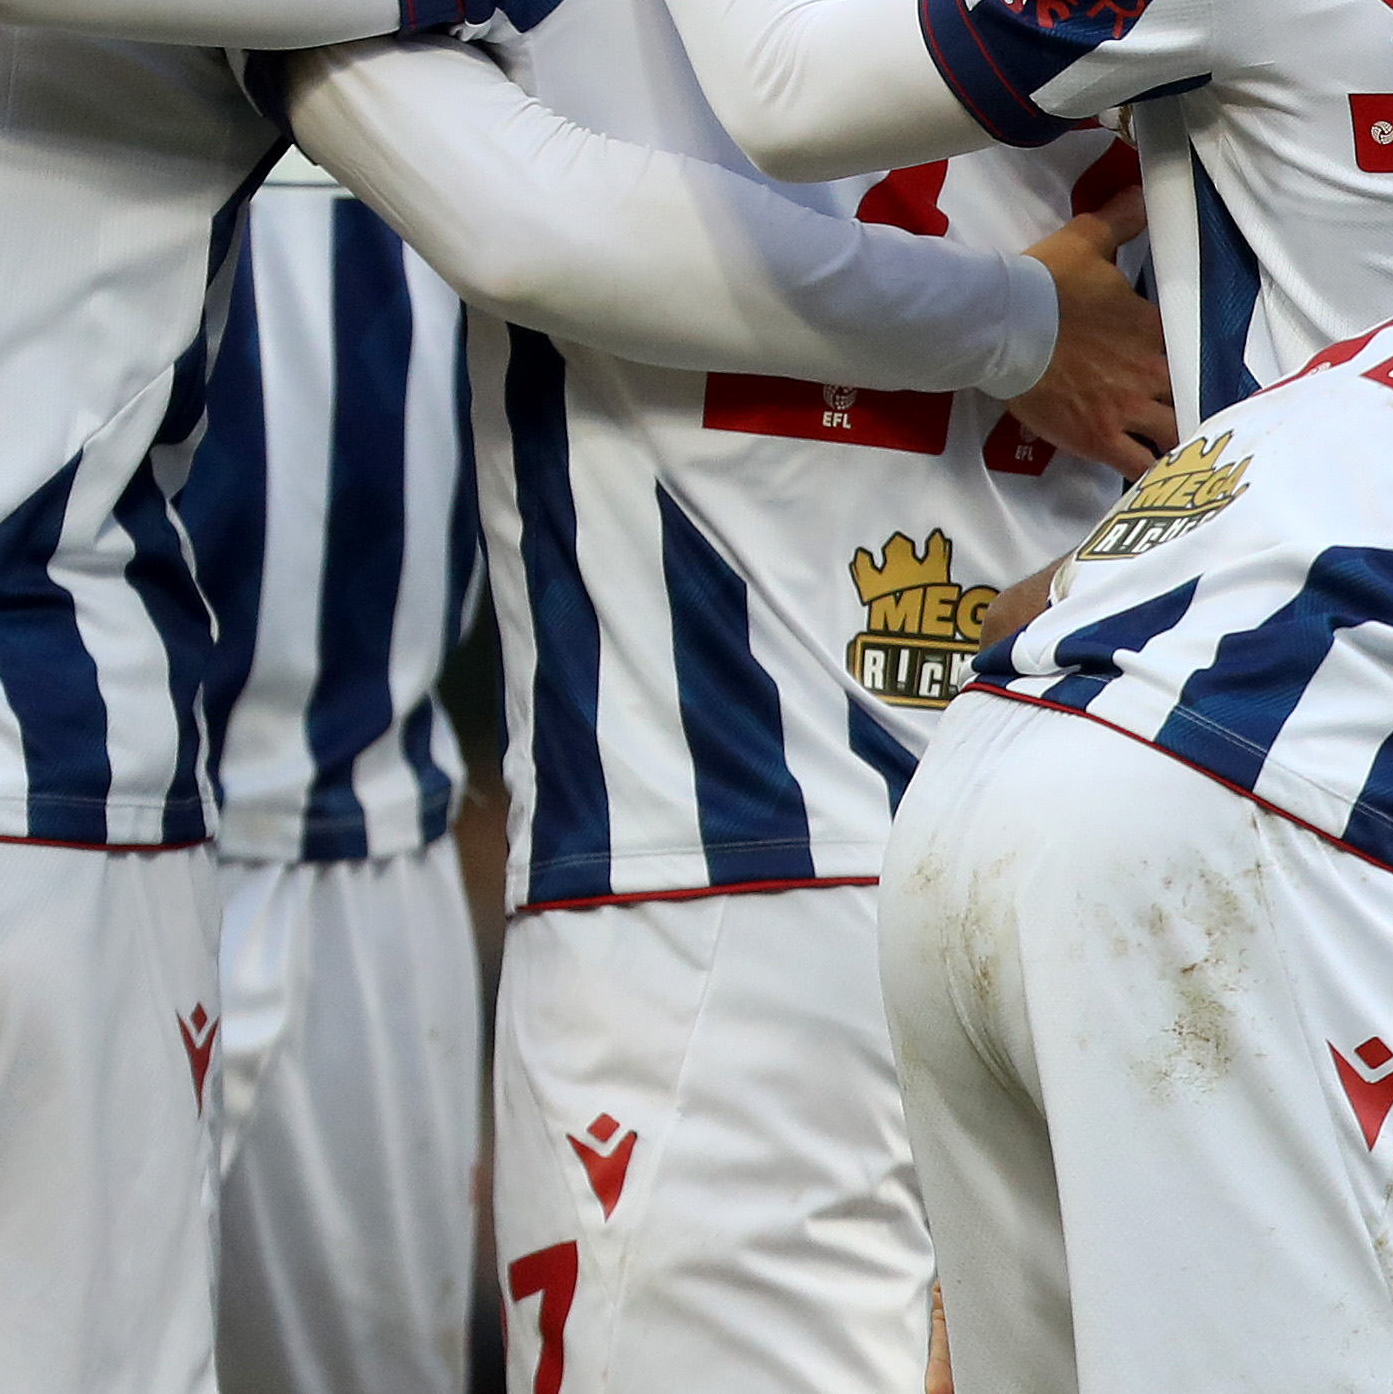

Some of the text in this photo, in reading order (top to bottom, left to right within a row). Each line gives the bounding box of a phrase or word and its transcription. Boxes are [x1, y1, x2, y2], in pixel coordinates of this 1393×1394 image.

[822, 410, 852, 429] EFL
[1014, 444, 1034, 461] EFL
[868, 584, 1000, 640] MEG
